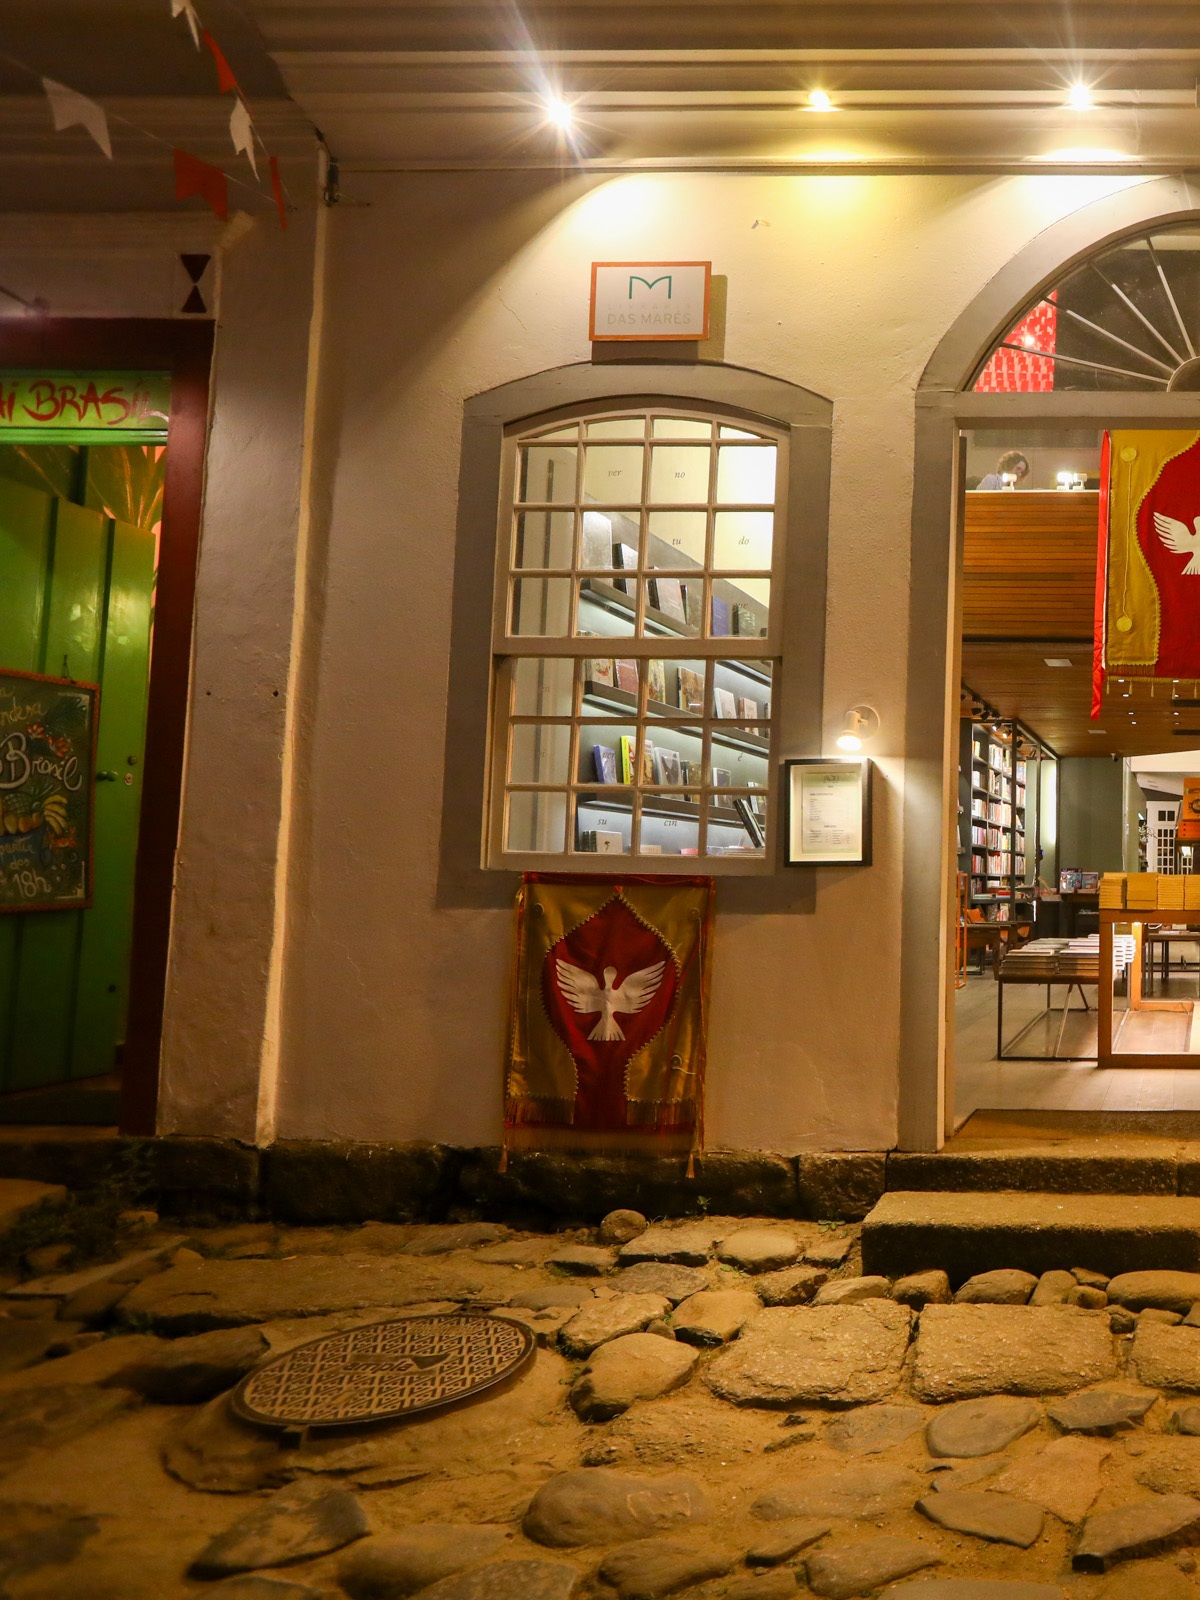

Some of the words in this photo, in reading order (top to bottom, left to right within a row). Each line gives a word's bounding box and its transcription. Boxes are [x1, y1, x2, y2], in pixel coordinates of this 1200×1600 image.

[607, 313, 636, 325] DAS
[641, 310, 692, 325] MARÉS
[738, 536, 750, 545] do
[0, 731, 83, 791] Brasil
[12, 867, 53, 899] 18h
[343, 1360, 413, 1374] ampla
